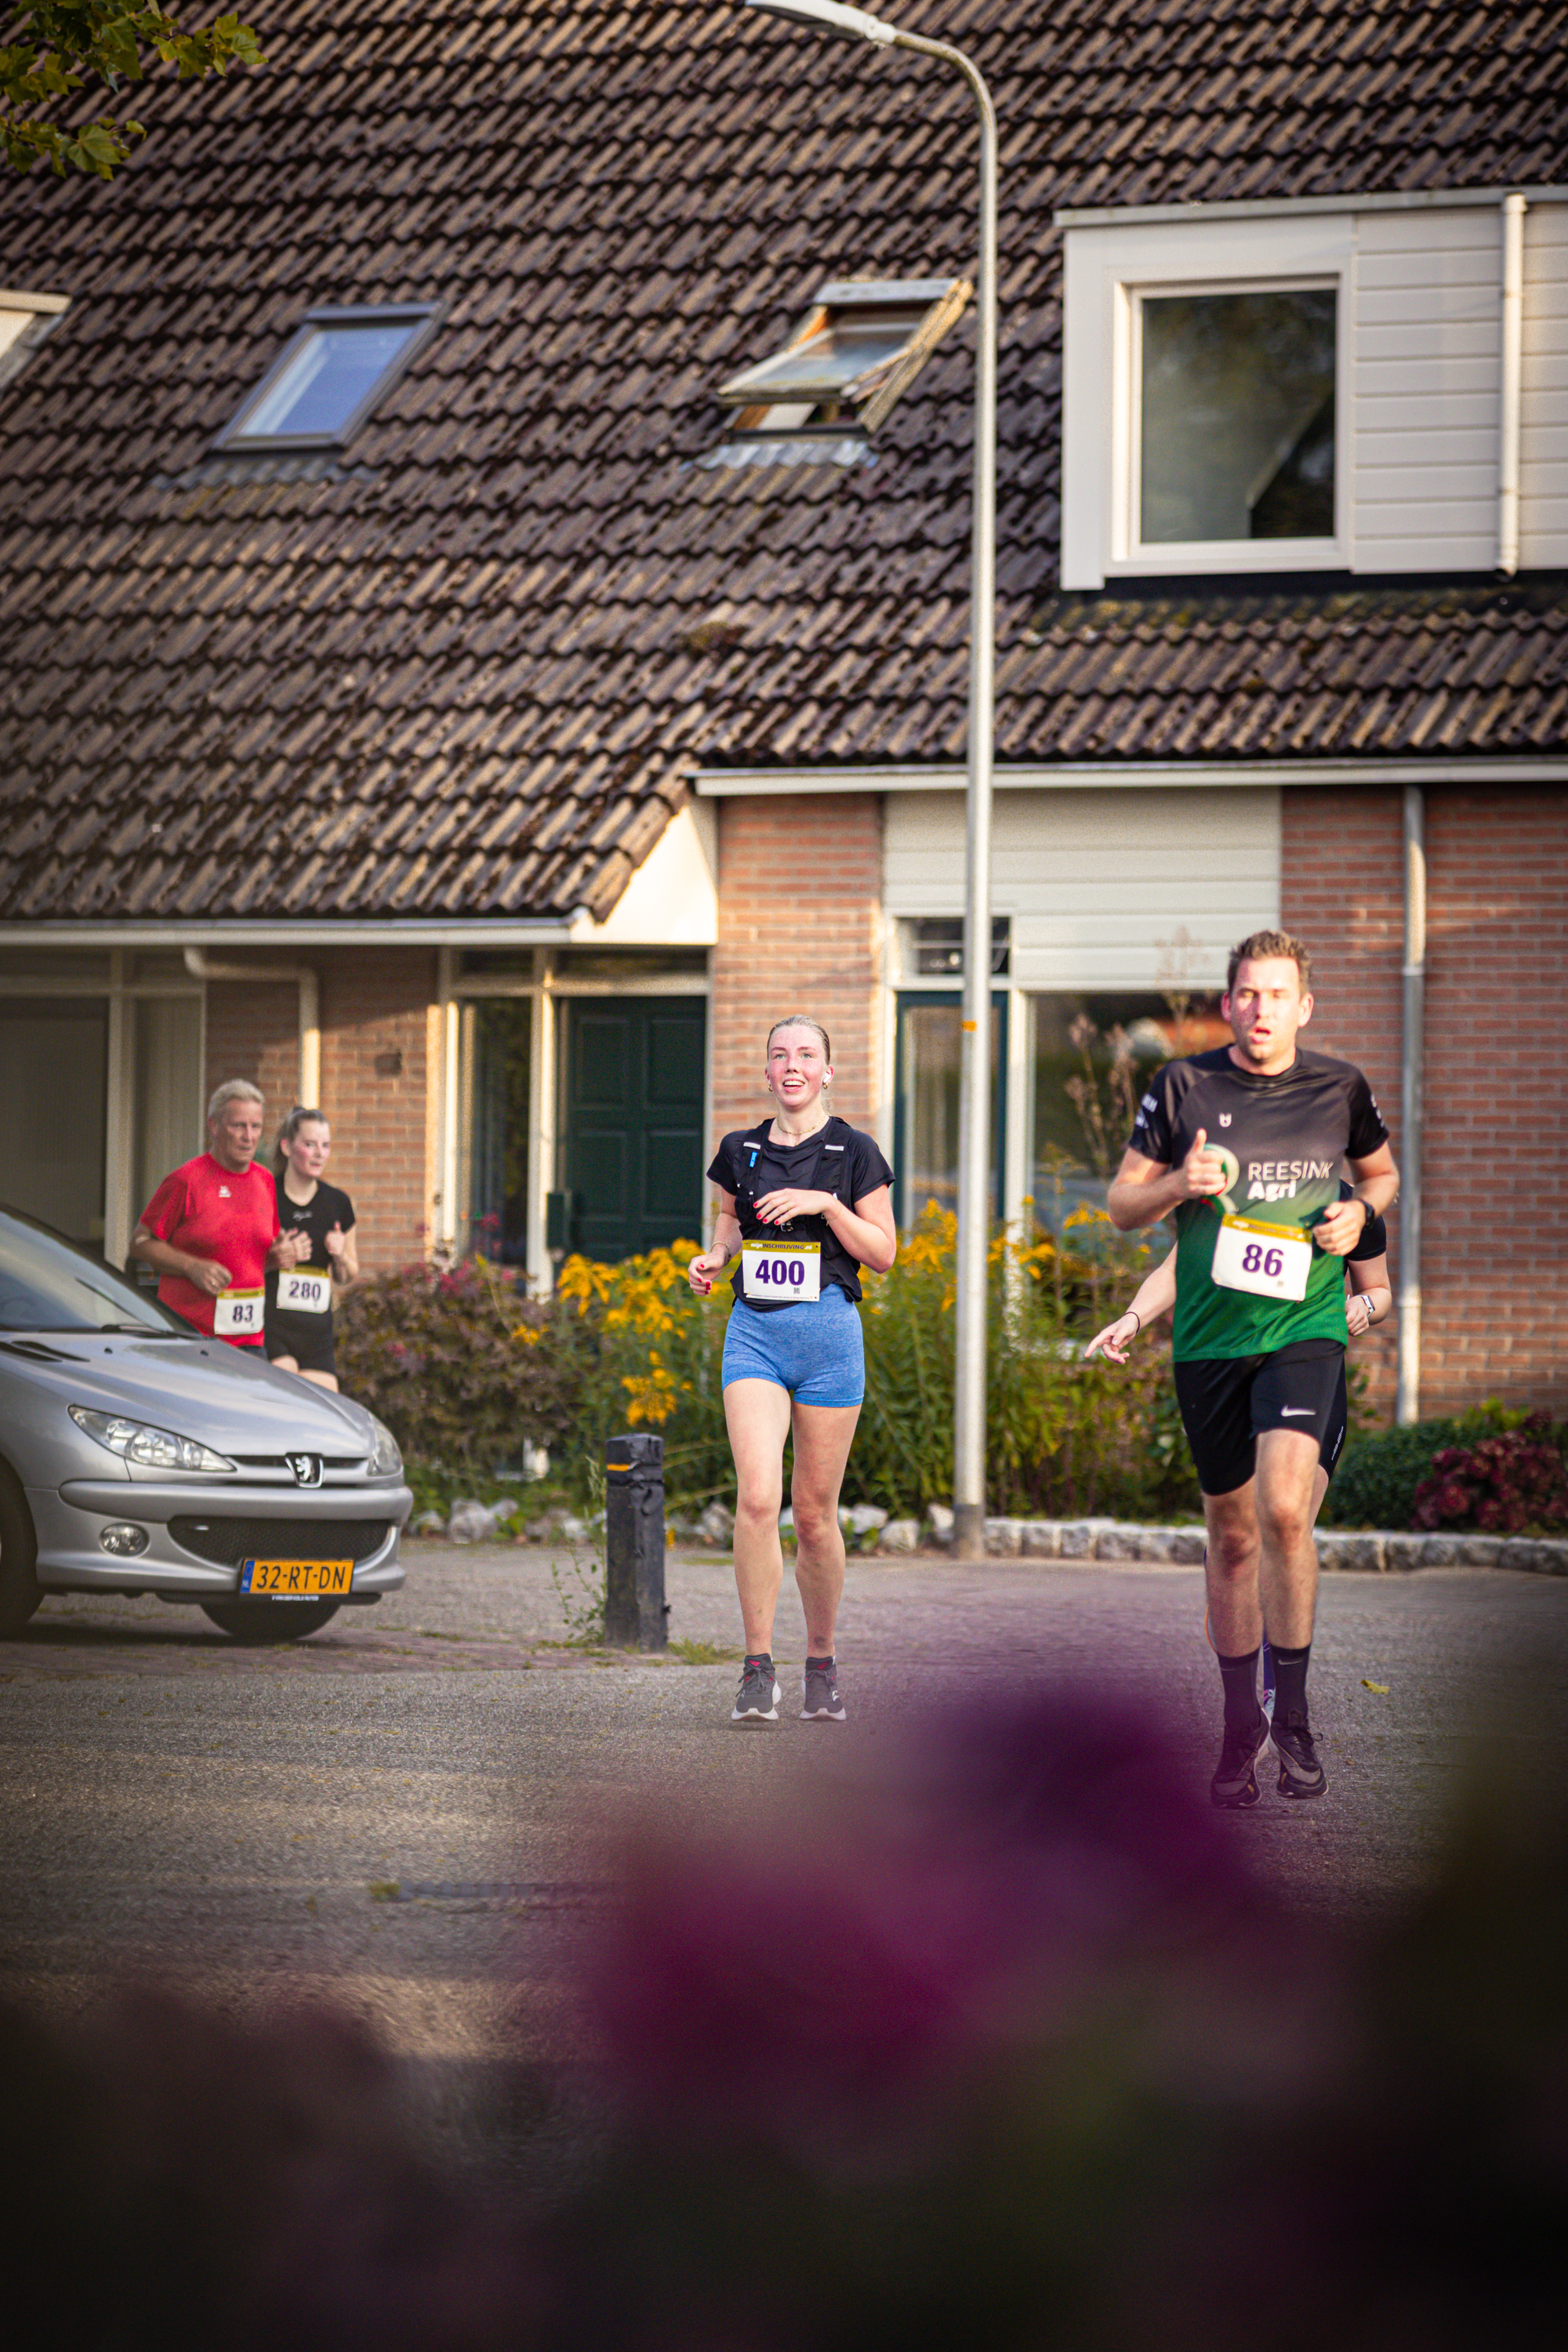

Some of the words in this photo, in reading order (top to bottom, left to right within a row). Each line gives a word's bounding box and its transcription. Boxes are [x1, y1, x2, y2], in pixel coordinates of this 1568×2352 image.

[1248, 1160, 1334, 1181] REESINK
[1247, 1179, 1297, 1202] Agri
[1242, 1243, 1284, 1277] 86
[755, 1259, 805, 1286] 400
[289, 1281, 321, 1301] 280
[232, 1305, 253, 1323] 83
[256, 1565, 346, 1590] 32-RT-DN
